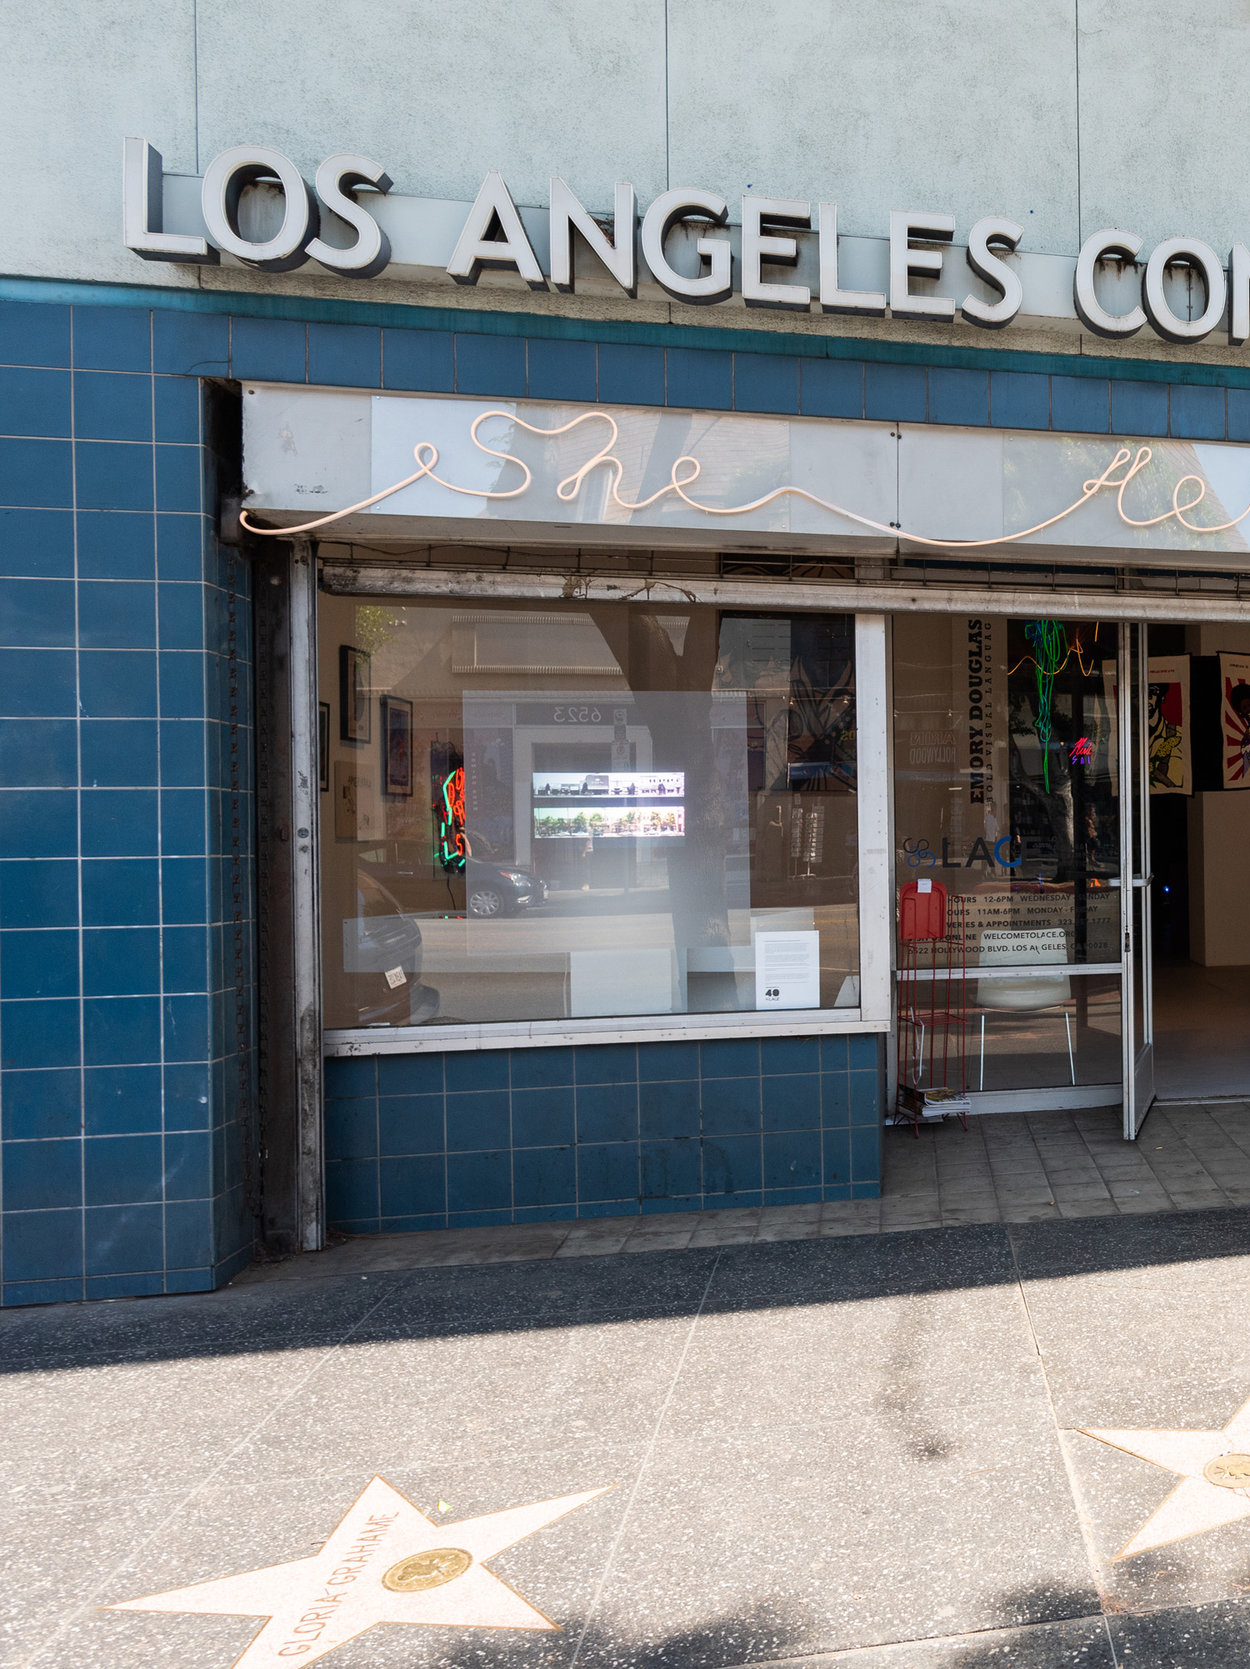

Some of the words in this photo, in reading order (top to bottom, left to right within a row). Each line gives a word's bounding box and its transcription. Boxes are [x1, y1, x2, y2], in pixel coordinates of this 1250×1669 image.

[123, 136, 393, 278] LOS
[447, 170, 1024, 329] ANGELES
[412, 410, 735, 515] She
[968, 619, 984, 721] DOUGLAS
[985, 702, 993, 756] VISUAL
[969, 725, 985, 804] EMORY
[978, 907, 1020, 916] 11AM-6PM
[1027, 906, 1063, 915] MONDAY
[984, 895, 1014, 903] 12-6PM
[1020, 893, 1071, 902] WEDNESDAY
[943, 933, 977, 942] ONLNE
[986, 919, 1051, 928] APPOINTMENTS
[988, 944, 1010, 953] BLVD.
[1012, 944, 1027, 952] LOS
[765, 988, 780, 997] 40
[277, 1591, 349, 1657] GLORIA
[326, 1511, 400, 1587] GRAHAME
